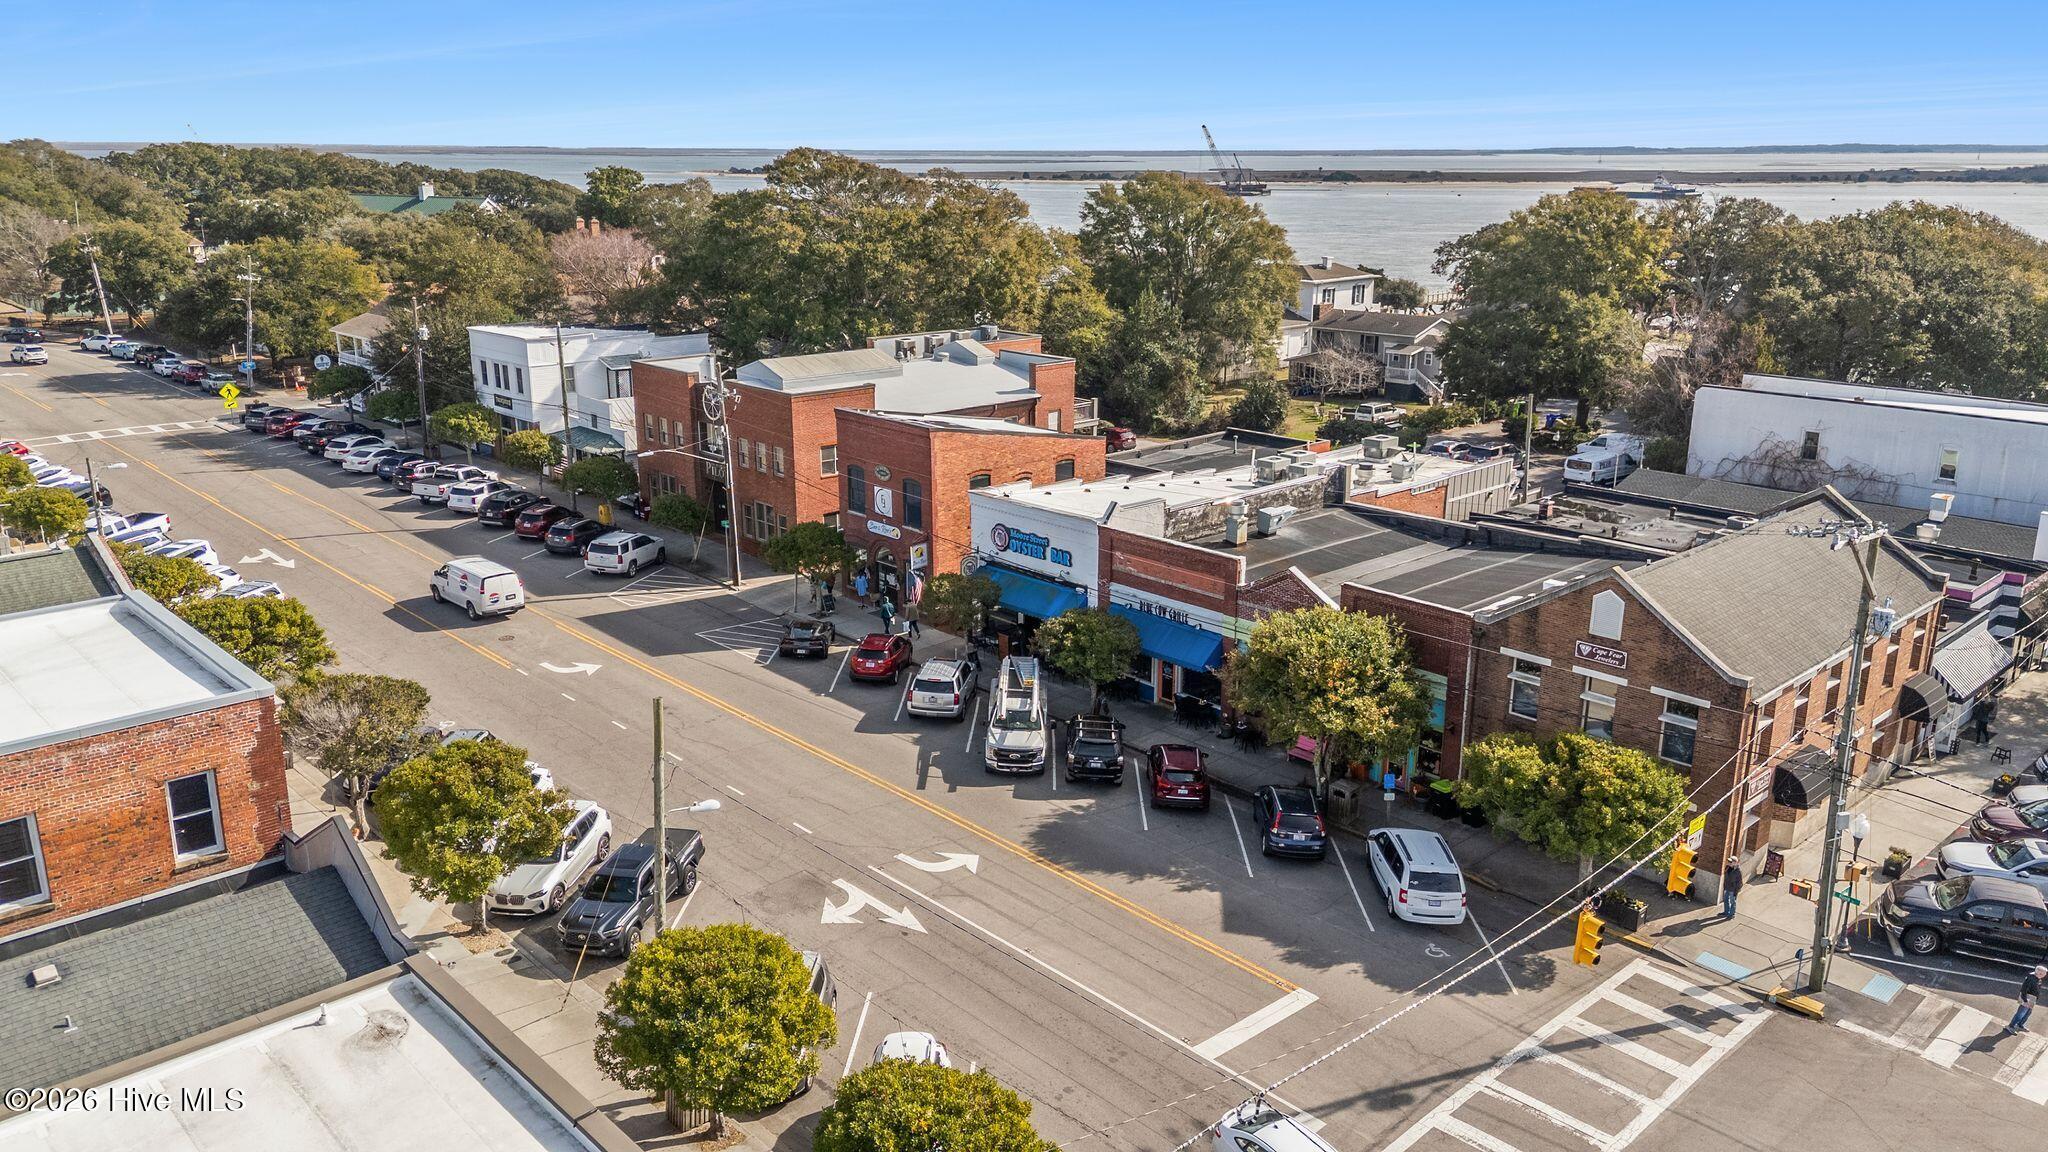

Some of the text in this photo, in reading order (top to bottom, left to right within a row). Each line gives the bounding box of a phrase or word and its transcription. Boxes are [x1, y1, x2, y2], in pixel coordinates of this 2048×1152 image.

[1009, 527, 1029, 541] Moore
[1029, 533, 1048, 546] Street
[1009, 538, 1071, 567] OYSTER BAR
[1139, 601, 1189, 624] BLUE COW GRILLE
[1592, 647, 1623, 659] Cape Fear
[1594, 655, 1619, 665] Jewelers
